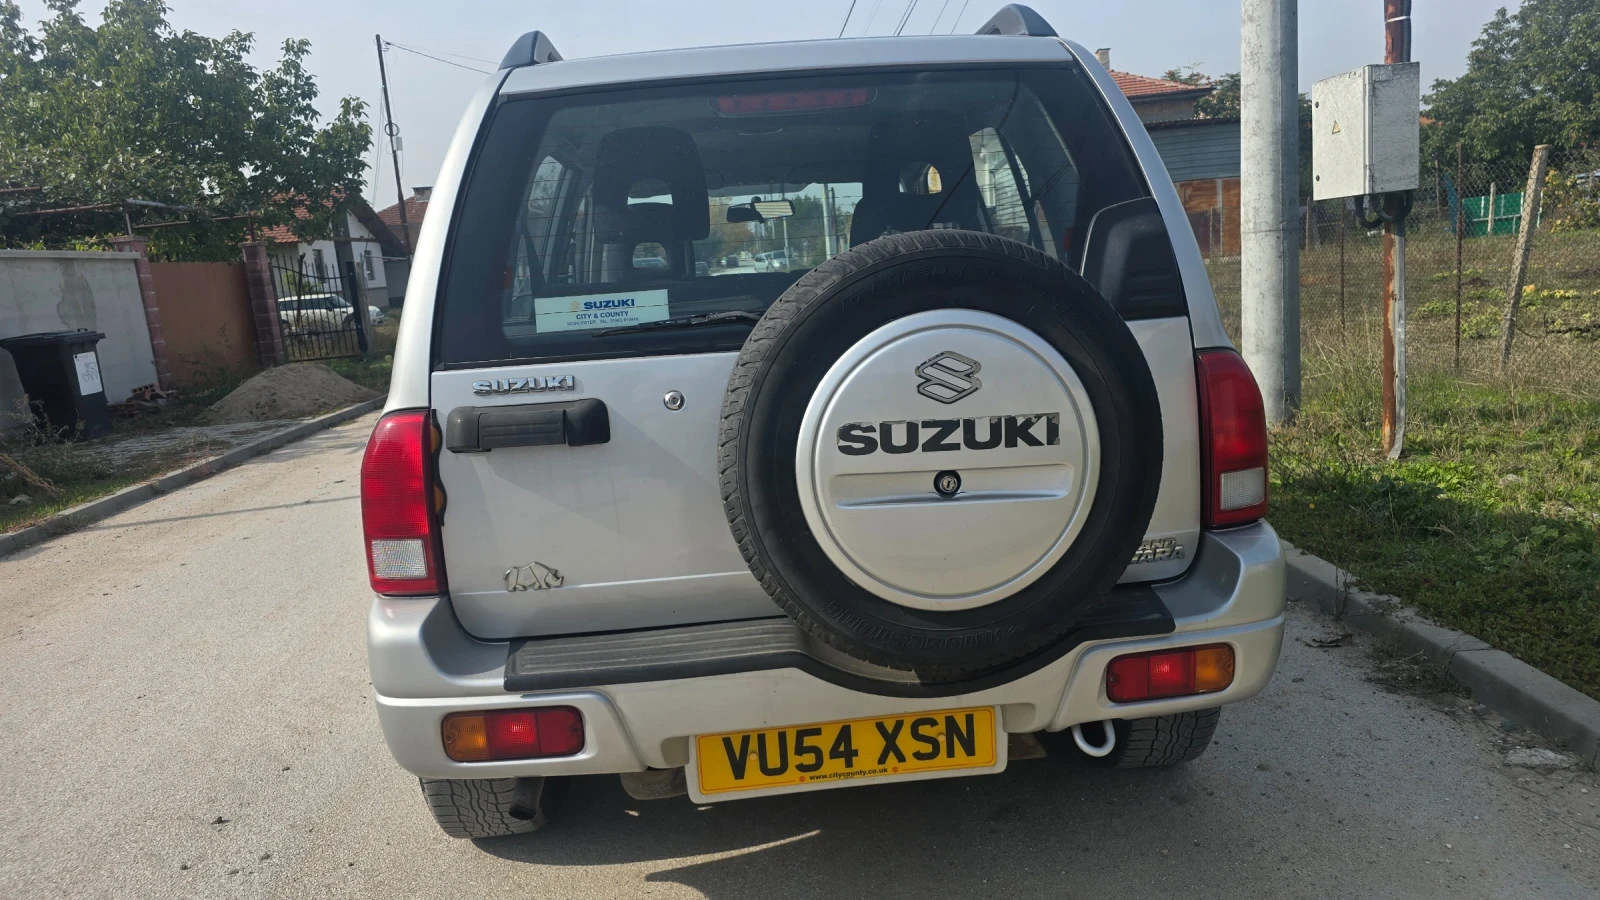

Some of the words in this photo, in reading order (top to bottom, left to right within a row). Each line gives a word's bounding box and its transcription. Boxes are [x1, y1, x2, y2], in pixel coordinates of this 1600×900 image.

[583, 298, 635, 310] SUZUKI
[600, 311, 629, 319] COUNTY
[472, 375, 575, 396] SUZUKI
[837, 412, 1060, 456] SUZUKI
[1137, 537, 1177, 552] AND
[1131, 544, 1186, 565] TARA
[721, 724, 858, 781] VU54
[875, 713, 976, 765] XSN
[809, 767, 888, 781] www.citycounty.co.uk
